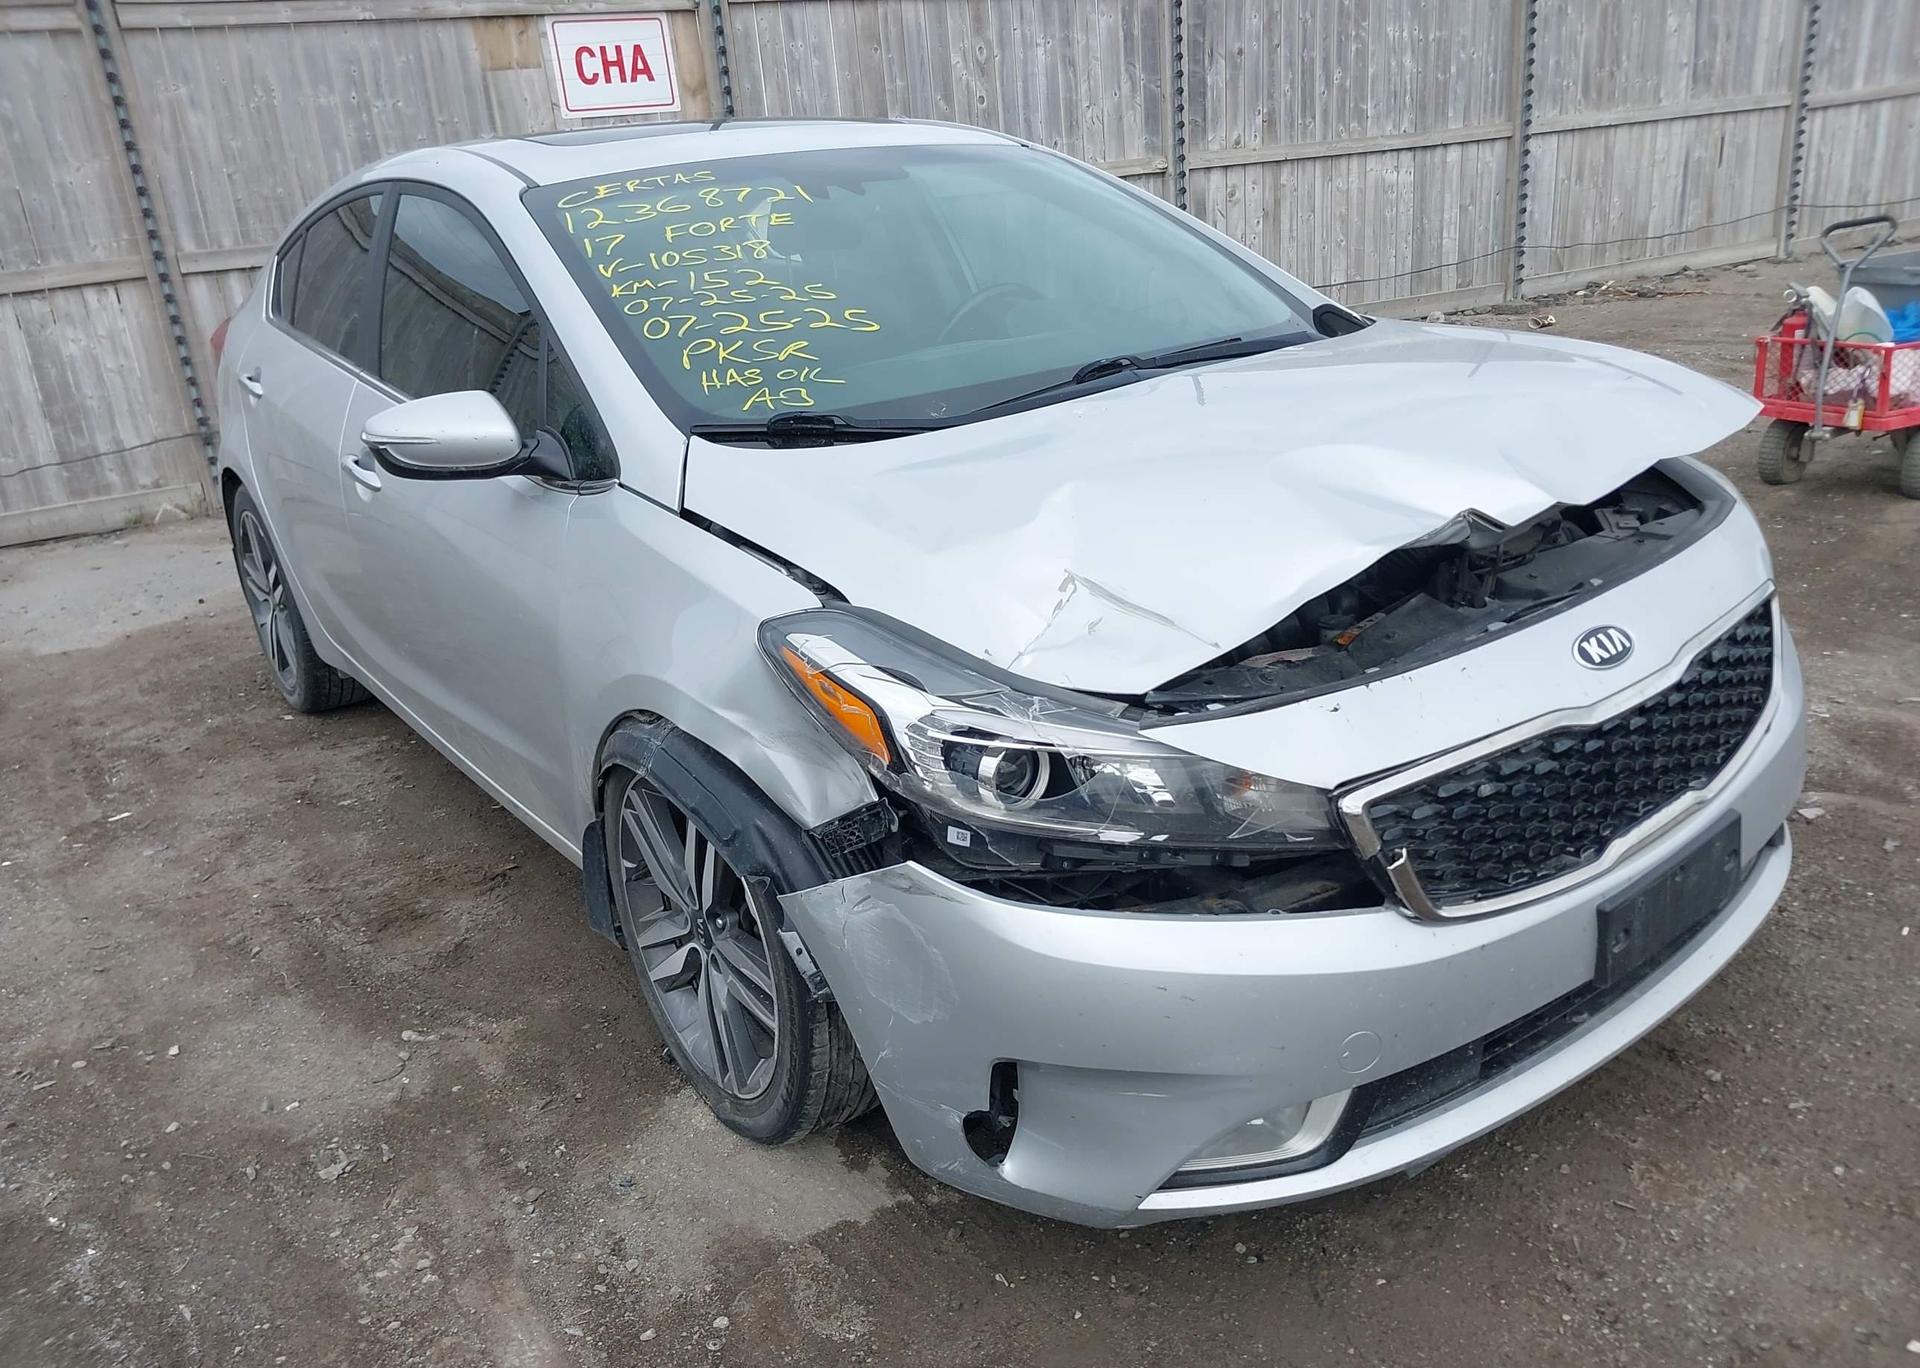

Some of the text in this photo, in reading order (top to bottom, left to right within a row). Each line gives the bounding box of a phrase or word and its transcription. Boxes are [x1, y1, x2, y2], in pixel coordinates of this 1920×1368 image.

[575, 44, 655, 85] CHA
[558, 170, 716, 208] CERTAS
[583, 212, 795, 259] 17 FORTE
[1580, 628, 1631, 664] KIA
